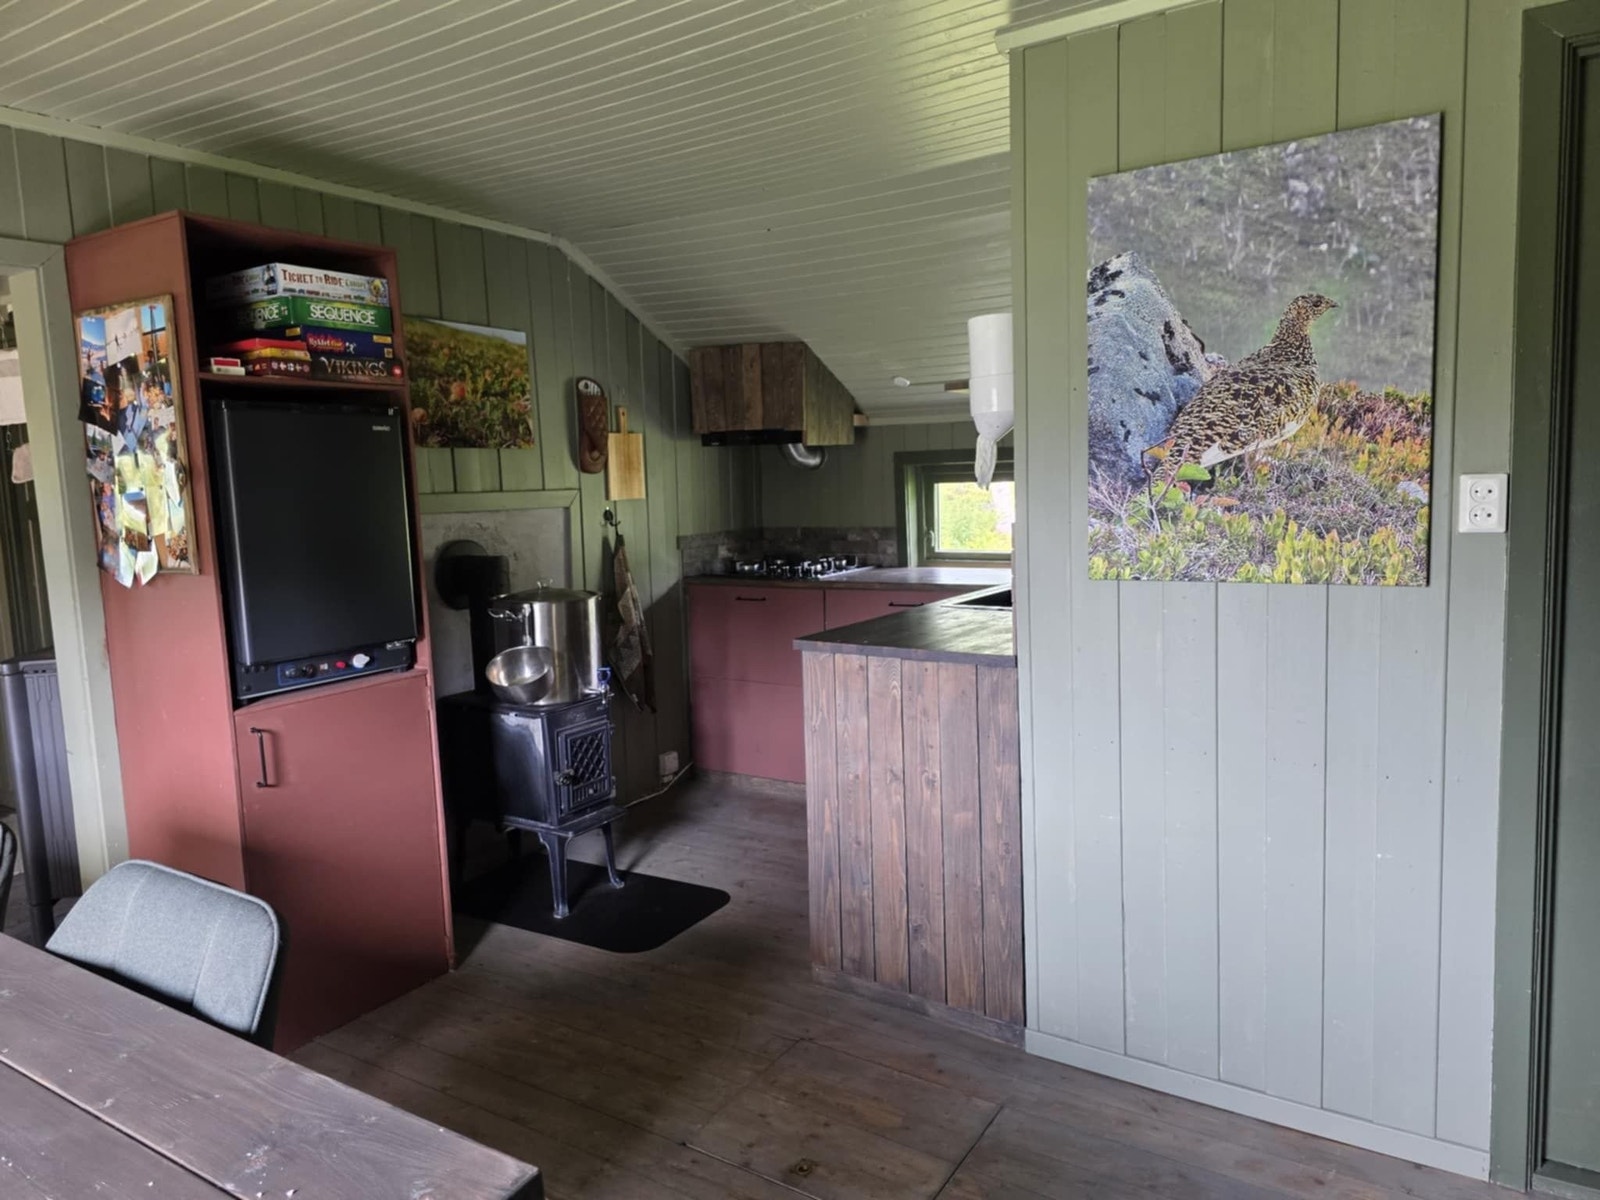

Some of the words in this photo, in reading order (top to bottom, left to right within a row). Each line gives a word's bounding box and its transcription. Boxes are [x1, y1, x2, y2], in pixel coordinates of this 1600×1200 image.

[281, 268, 314, 284] TICKET
[323, 273, 345, 288] RIDE
[309, 304, 376, 325] SEQUENCE
[319, 356, 387, 377] VIKINGS
